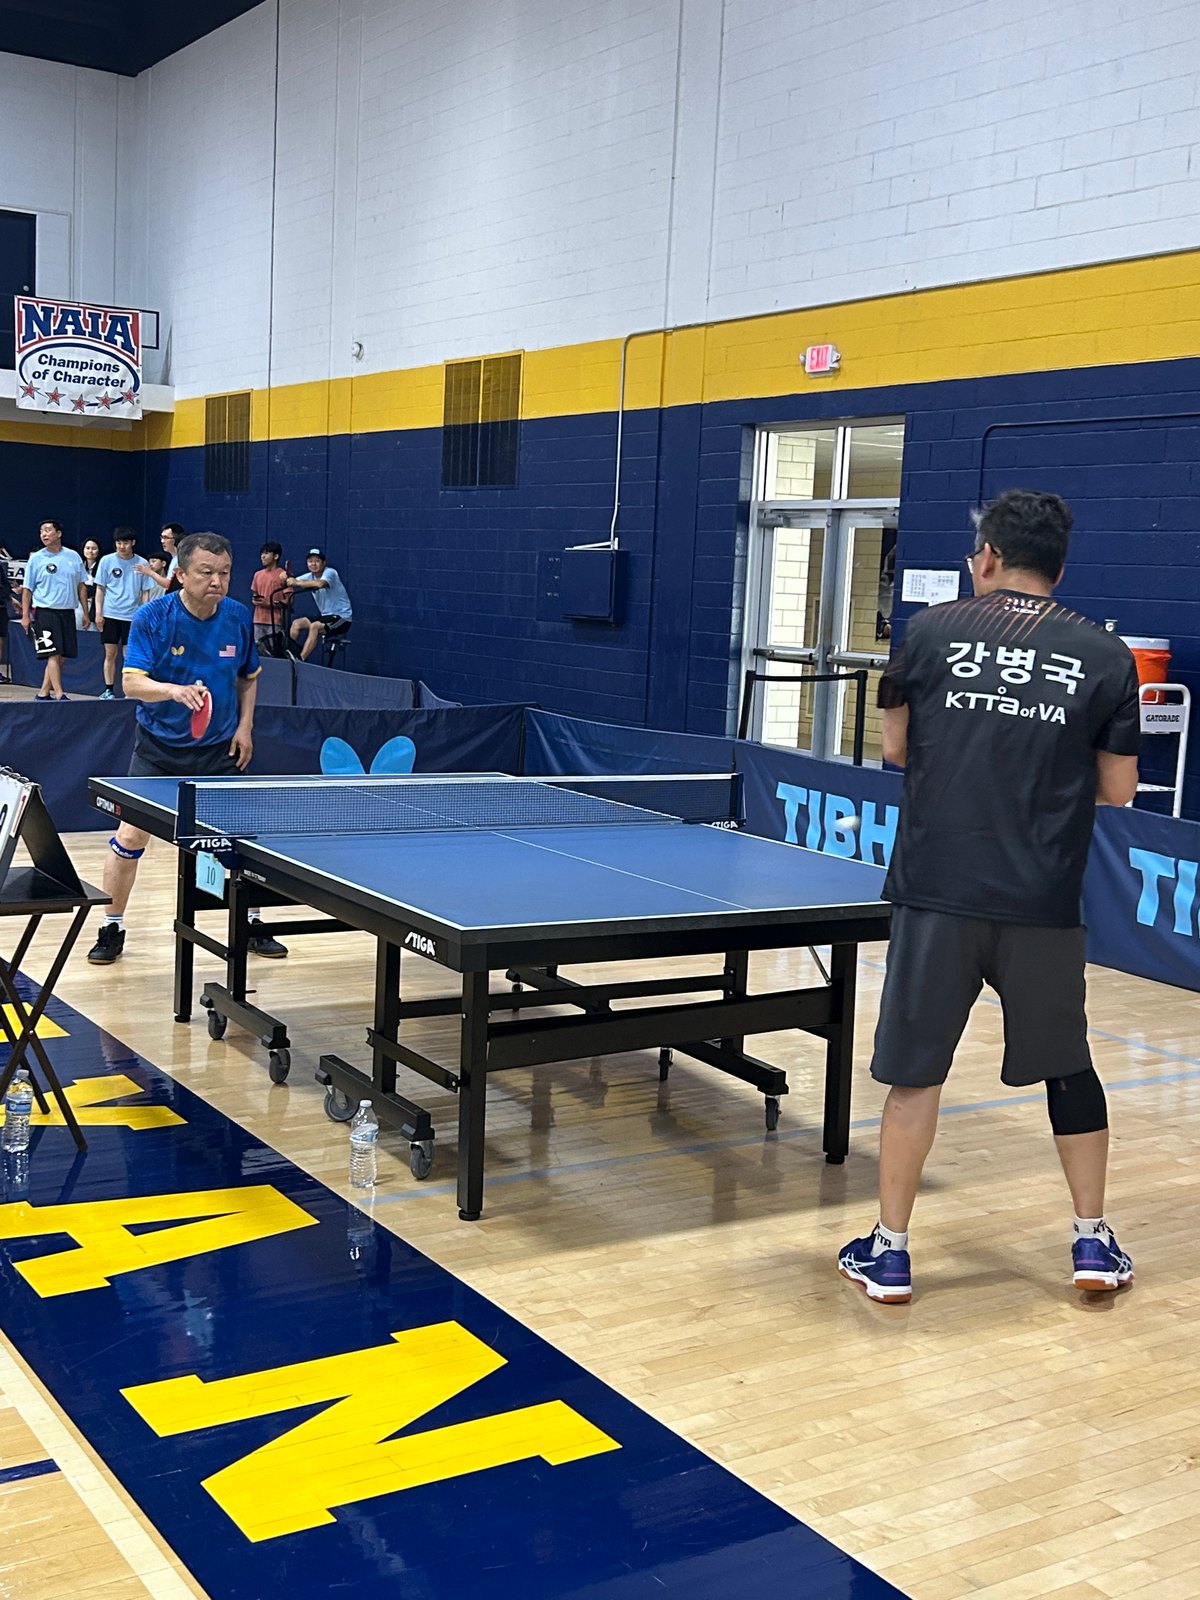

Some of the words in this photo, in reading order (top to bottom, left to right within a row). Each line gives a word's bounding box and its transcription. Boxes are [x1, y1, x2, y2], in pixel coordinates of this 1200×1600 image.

[21, 302, 136, 355] NAIA
[37, 353, 121, 373] Champions
[810, 346, 829, 370] EXIT
[32, 369, 50, 381] of
[53, 370, 126, 388] Character
[946, 641, 1085, 696] 강병국
[1019, 706, 1037, 718] of
[1038, 702, 1066, 725] VA
[1145, 714, 1181, 723] GATORADE
[189, 838, 232, 849] STIGA
[206, 866, 216, 886] 10
[1128, 846, 1200, 939] TI
[404, 931, 436, 957] STIGA
